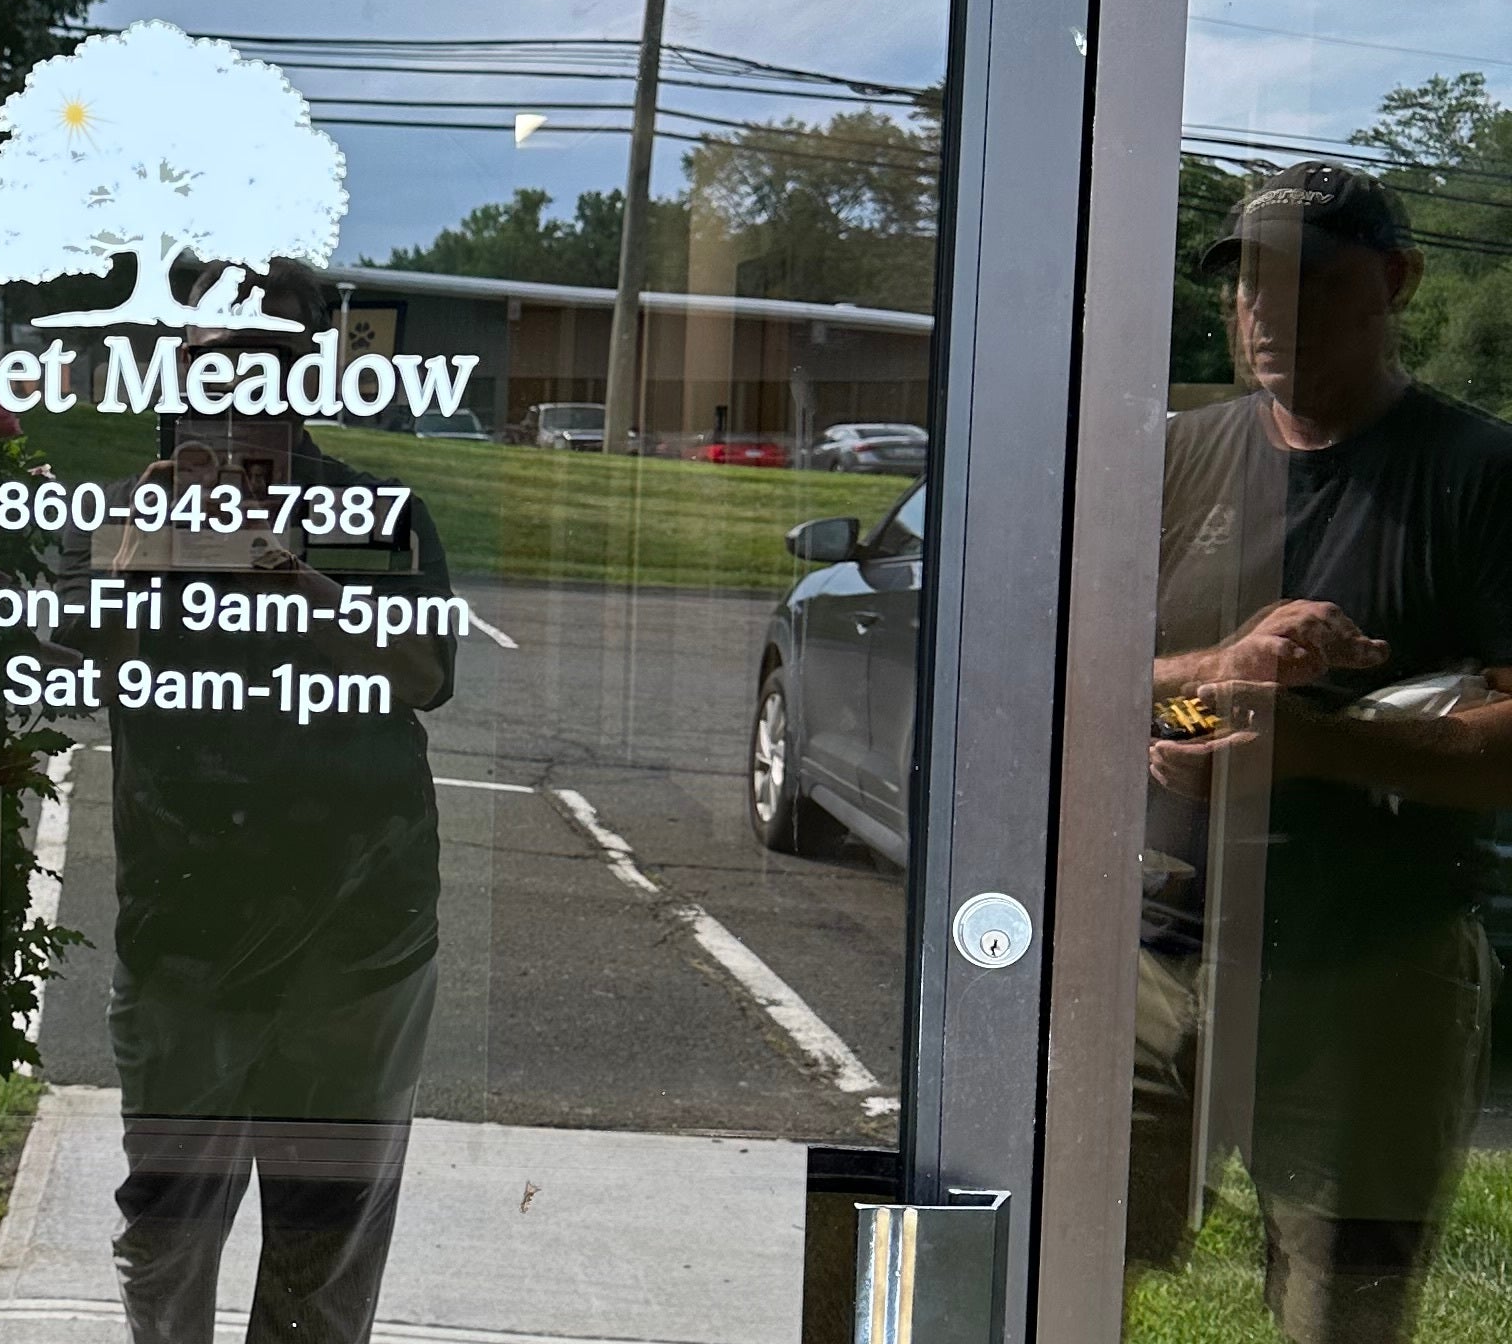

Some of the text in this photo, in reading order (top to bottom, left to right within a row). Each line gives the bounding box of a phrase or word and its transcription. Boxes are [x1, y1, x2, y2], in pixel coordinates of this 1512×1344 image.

[96, 327, 479, 418] Meadow
[181, 583, 470, 648] 9am-5pm
[3, 655, 392, 725] Sat 9am-1pm
